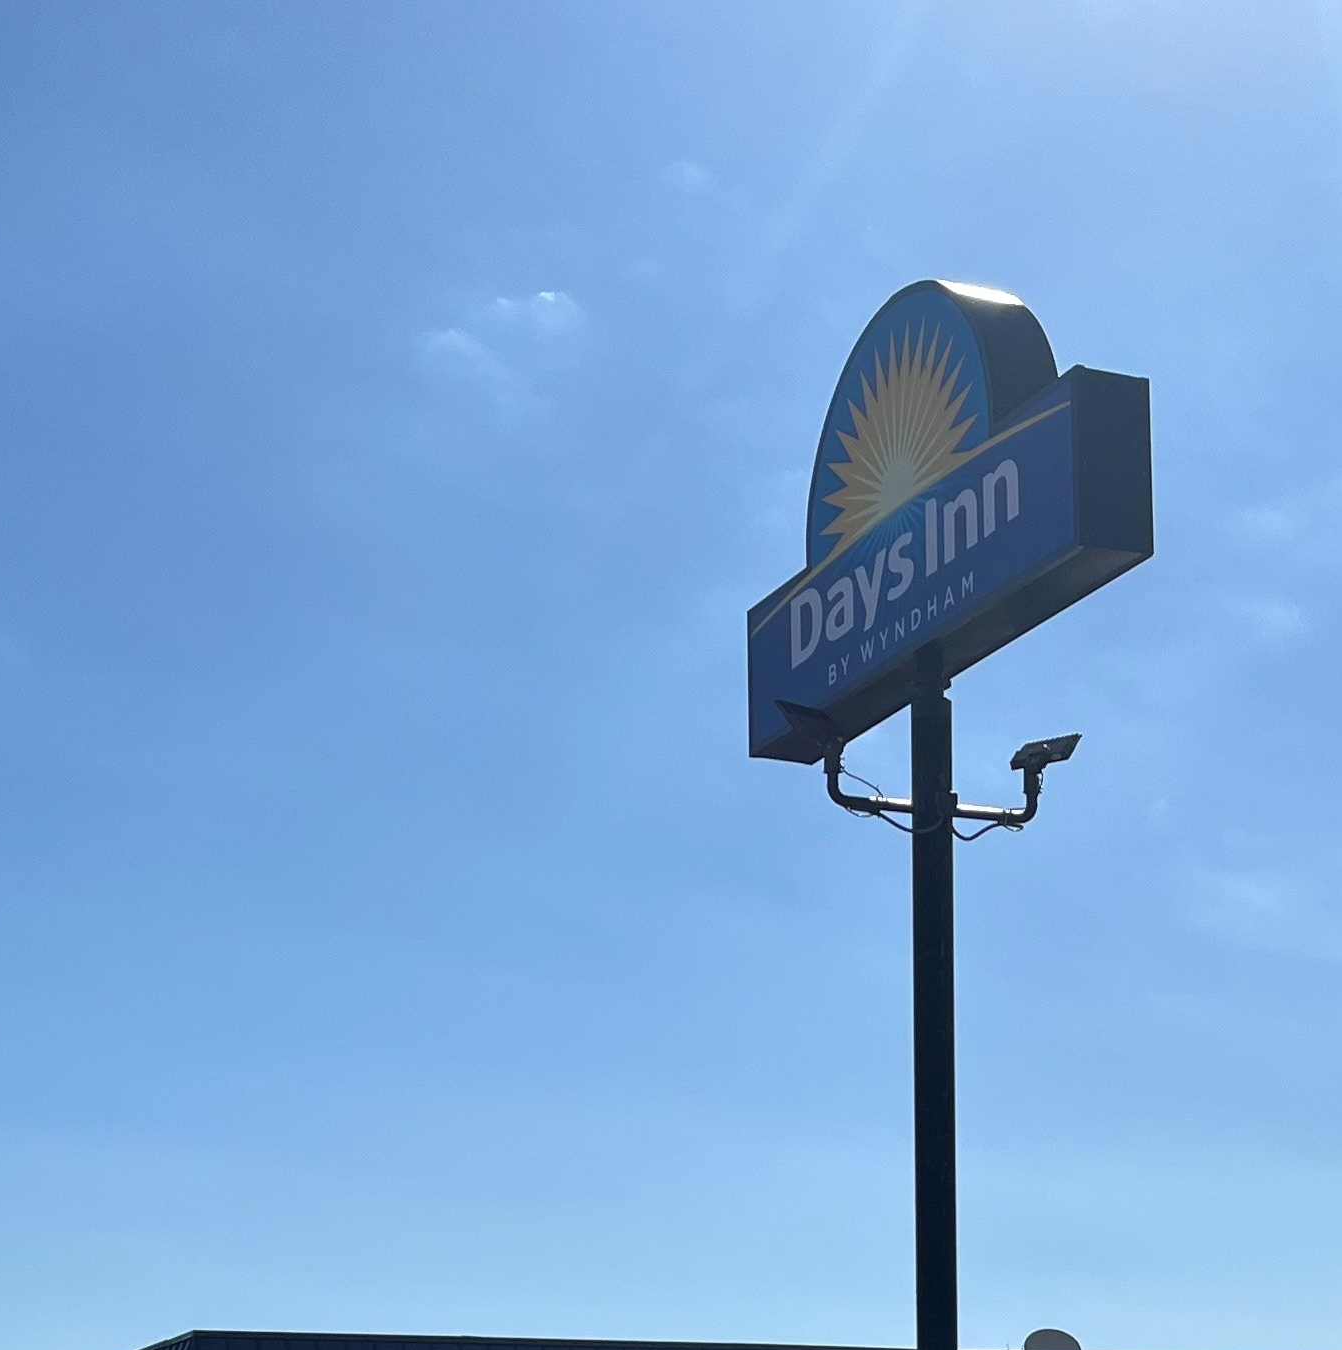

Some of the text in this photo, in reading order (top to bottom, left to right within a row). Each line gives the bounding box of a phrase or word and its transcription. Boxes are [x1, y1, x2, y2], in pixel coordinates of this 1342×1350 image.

[790, 458, 1020, 671] Days Inn
[827, 570, 975, 687] BY WYNDHAM
